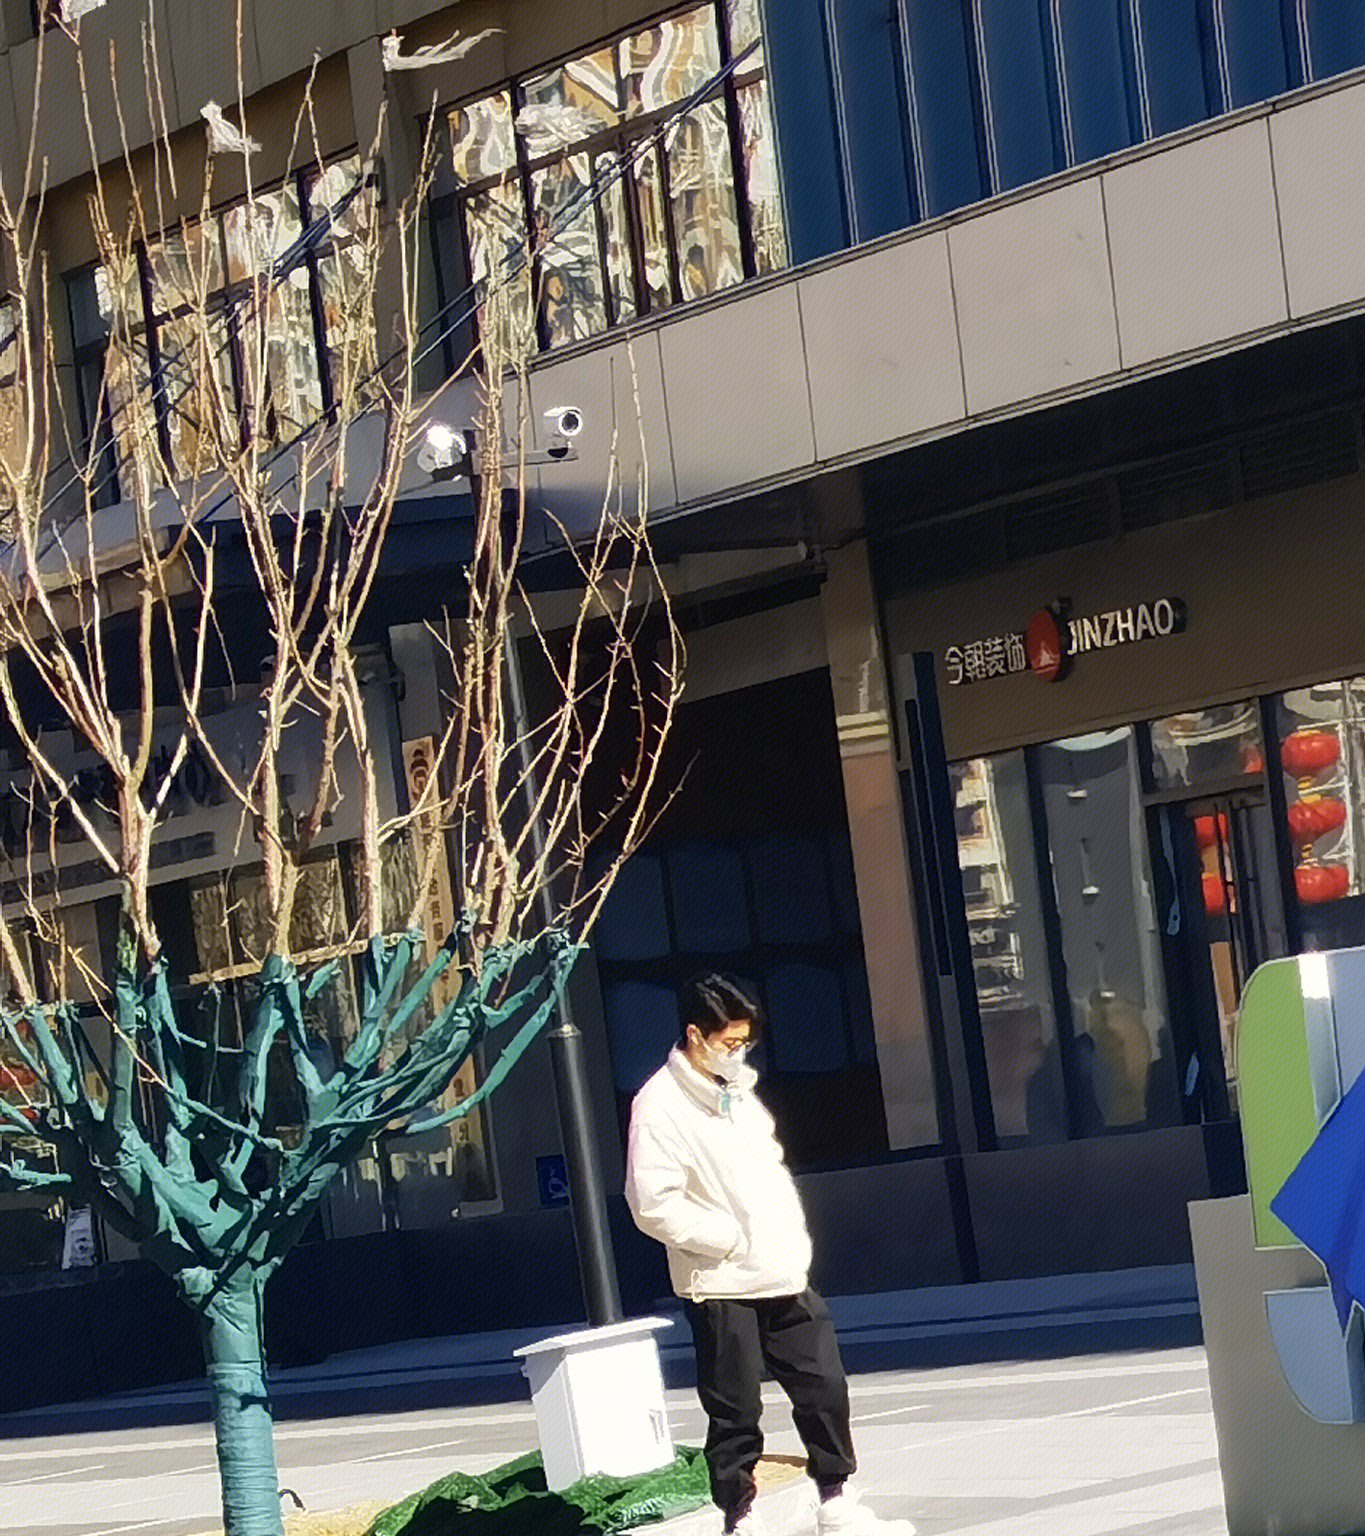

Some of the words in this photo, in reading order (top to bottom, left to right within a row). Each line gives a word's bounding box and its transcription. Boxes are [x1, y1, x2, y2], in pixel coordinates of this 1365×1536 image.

[1067, 598, 1174, 656] JINZHAO
[945, 633, 1027, 685] 今朝装饰
